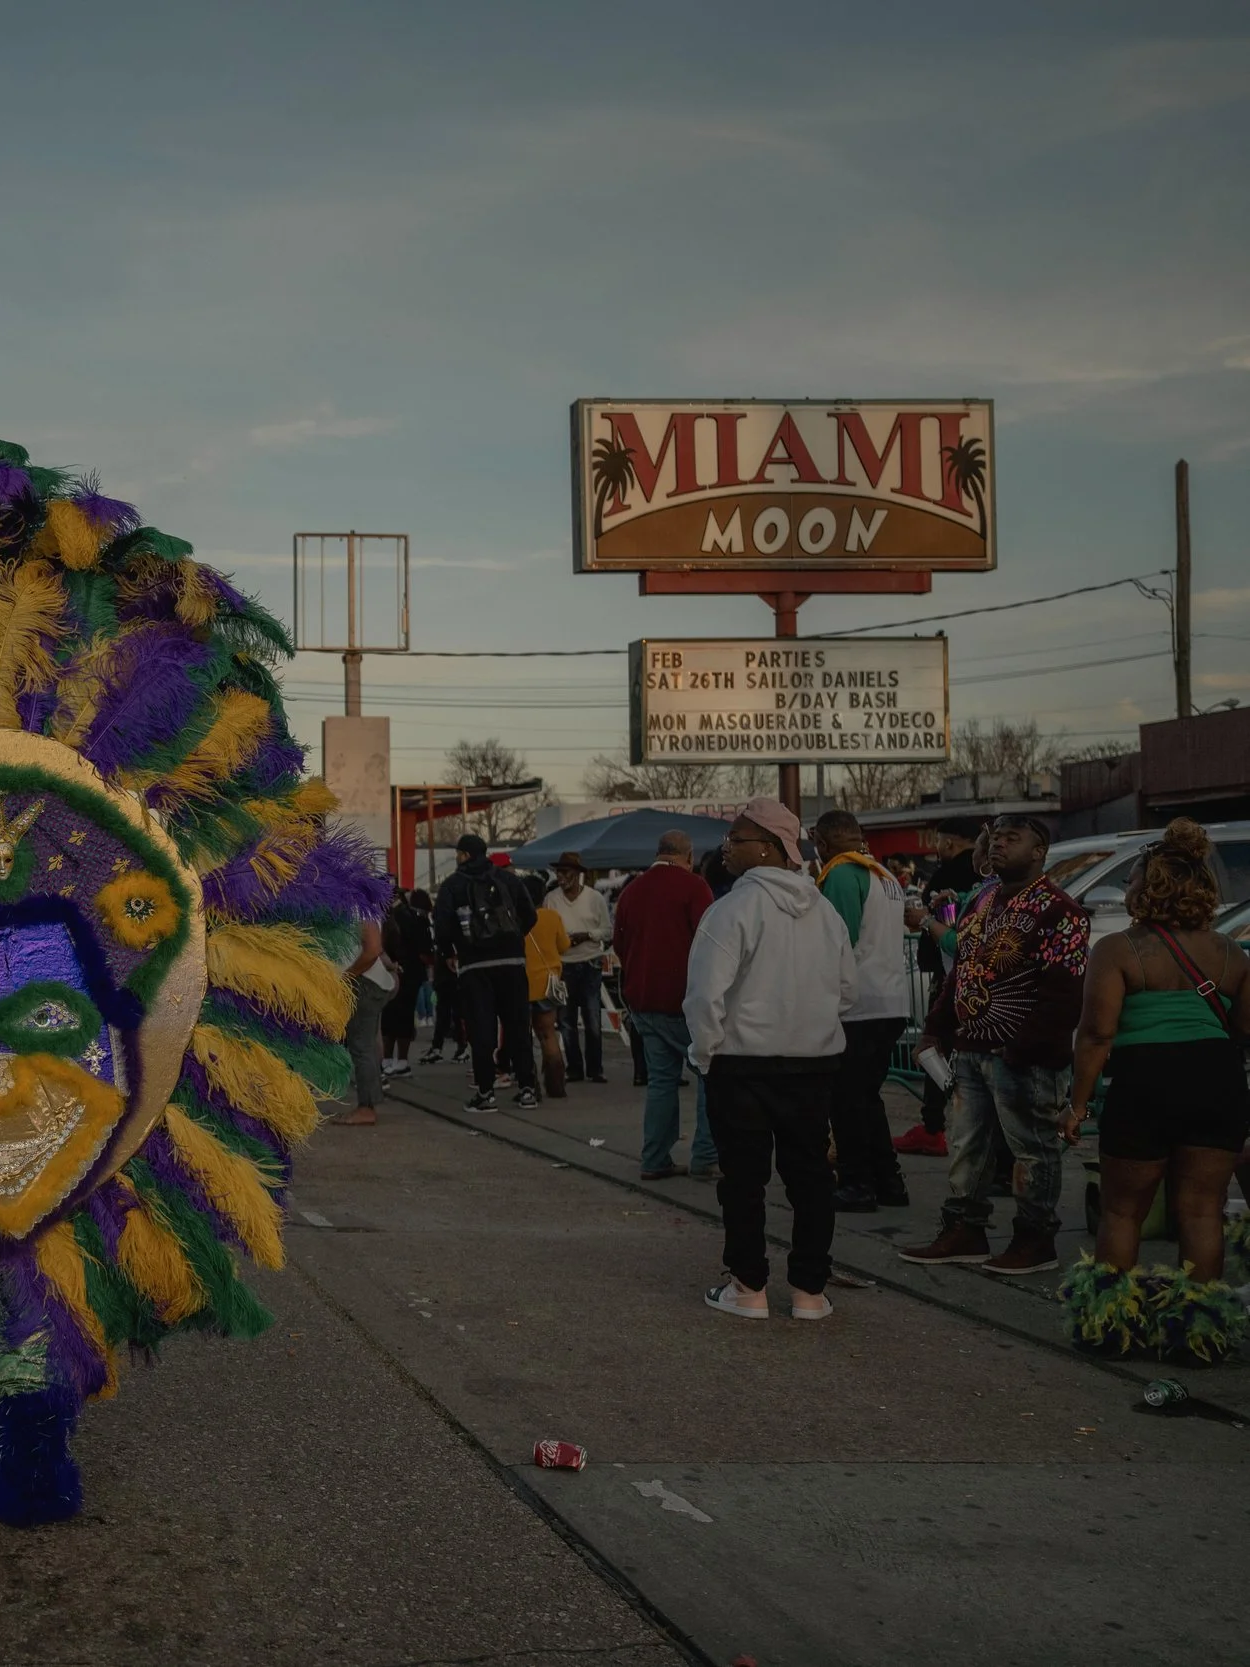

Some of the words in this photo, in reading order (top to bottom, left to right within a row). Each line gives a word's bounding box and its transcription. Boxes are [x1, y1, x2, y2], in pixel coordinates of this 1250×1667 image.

[601, 412, 973, 518] MIAMI
[700, 504, 889, 556] MOON
[651, 651, 683, 669] FEB
[745, 651, 825, 668] PARTIES
[646, 672, 681, 689] SAT
[689, 671, 735, 689] 26TH
[746, 671, 814, 689] SAILOR
[822, 670, 899, 688] DANIELS
[775, 692, 838, 709] B/DAY
[849, 692, 898, 708] BASH
[648, 713, 687, 731] MON
[699, 712, 822, 730] MASQUERADE
[831, 713, 843, 730] &
[863, 712, 935, 729] ZYDECO
